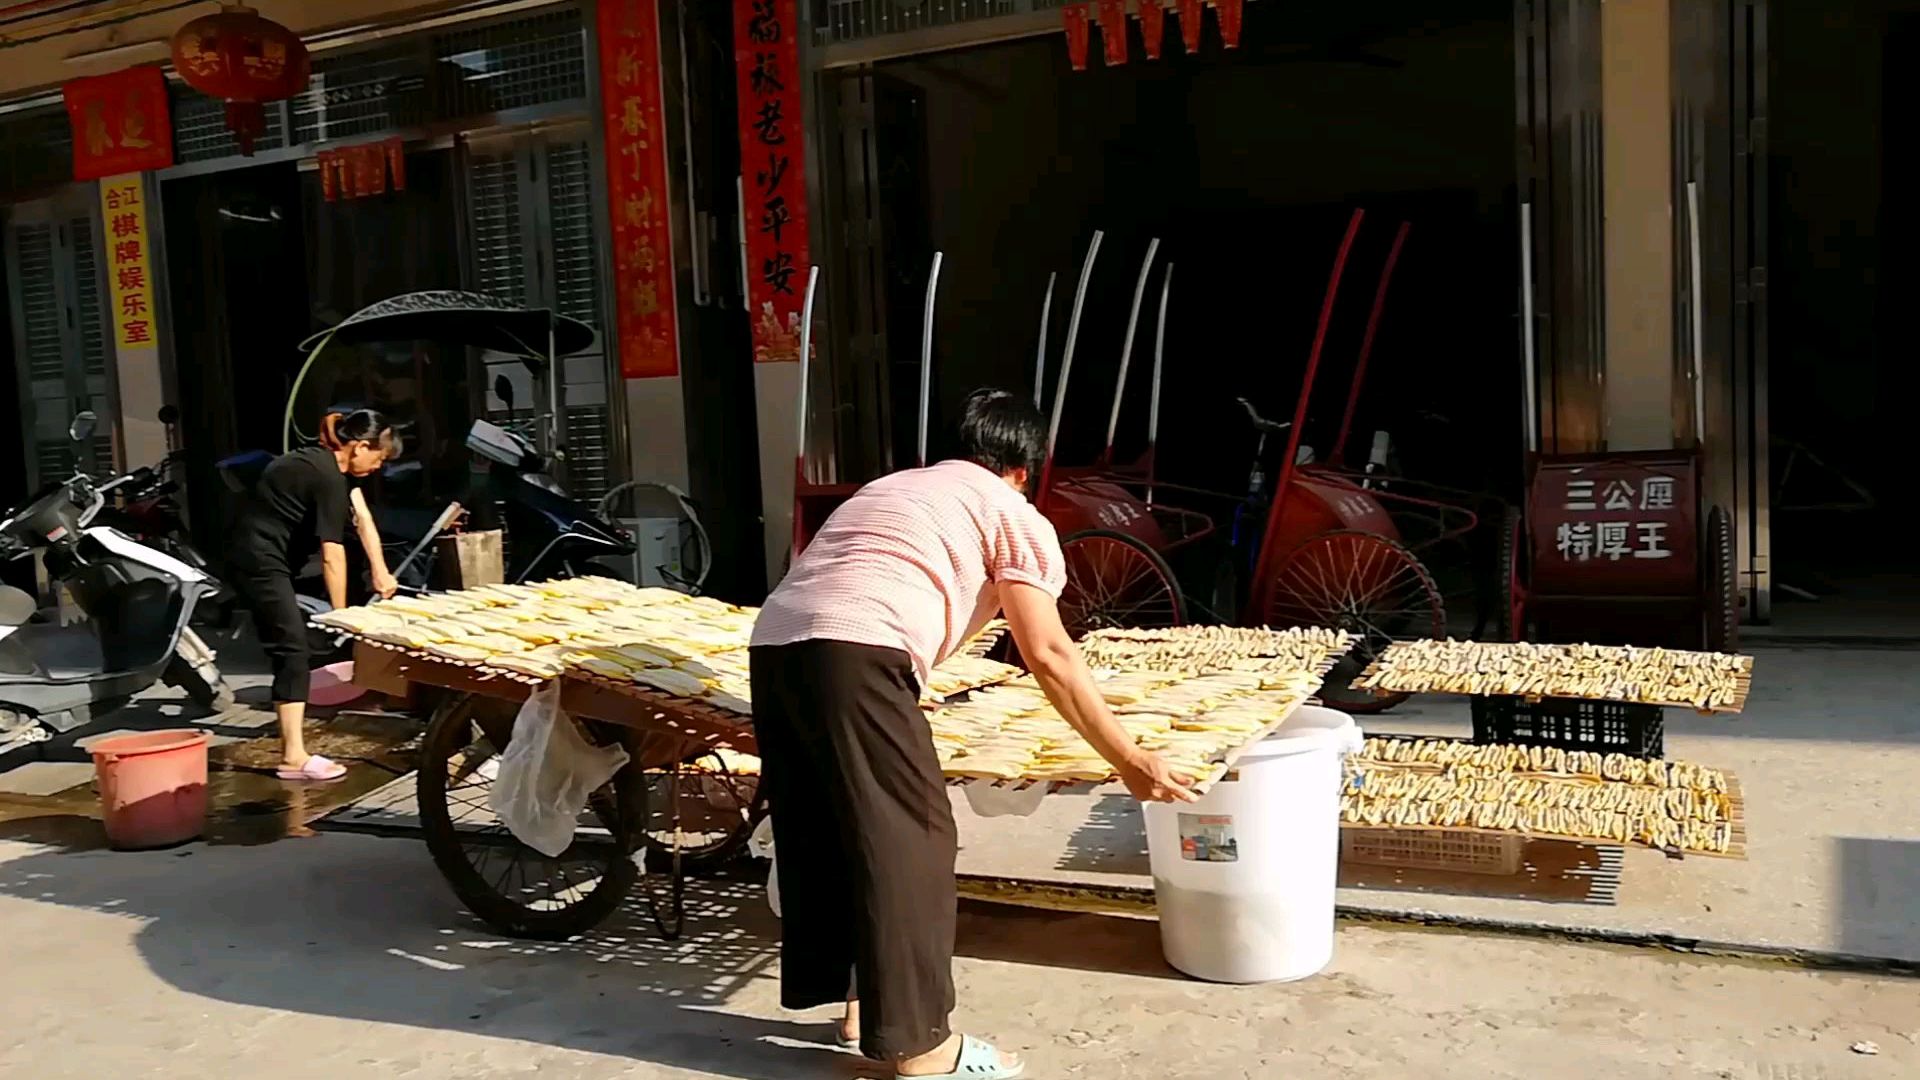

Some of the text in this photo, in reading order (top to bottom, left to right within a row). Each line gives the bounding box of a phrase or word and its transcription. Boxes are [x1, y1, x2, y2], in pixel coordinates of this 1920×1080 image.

[112, 213, 151, 344] 棋牌娱乐室
[1564, 476, 1675, 511] 三公厘
[1557, 522, 1672, 561] 特厚王
